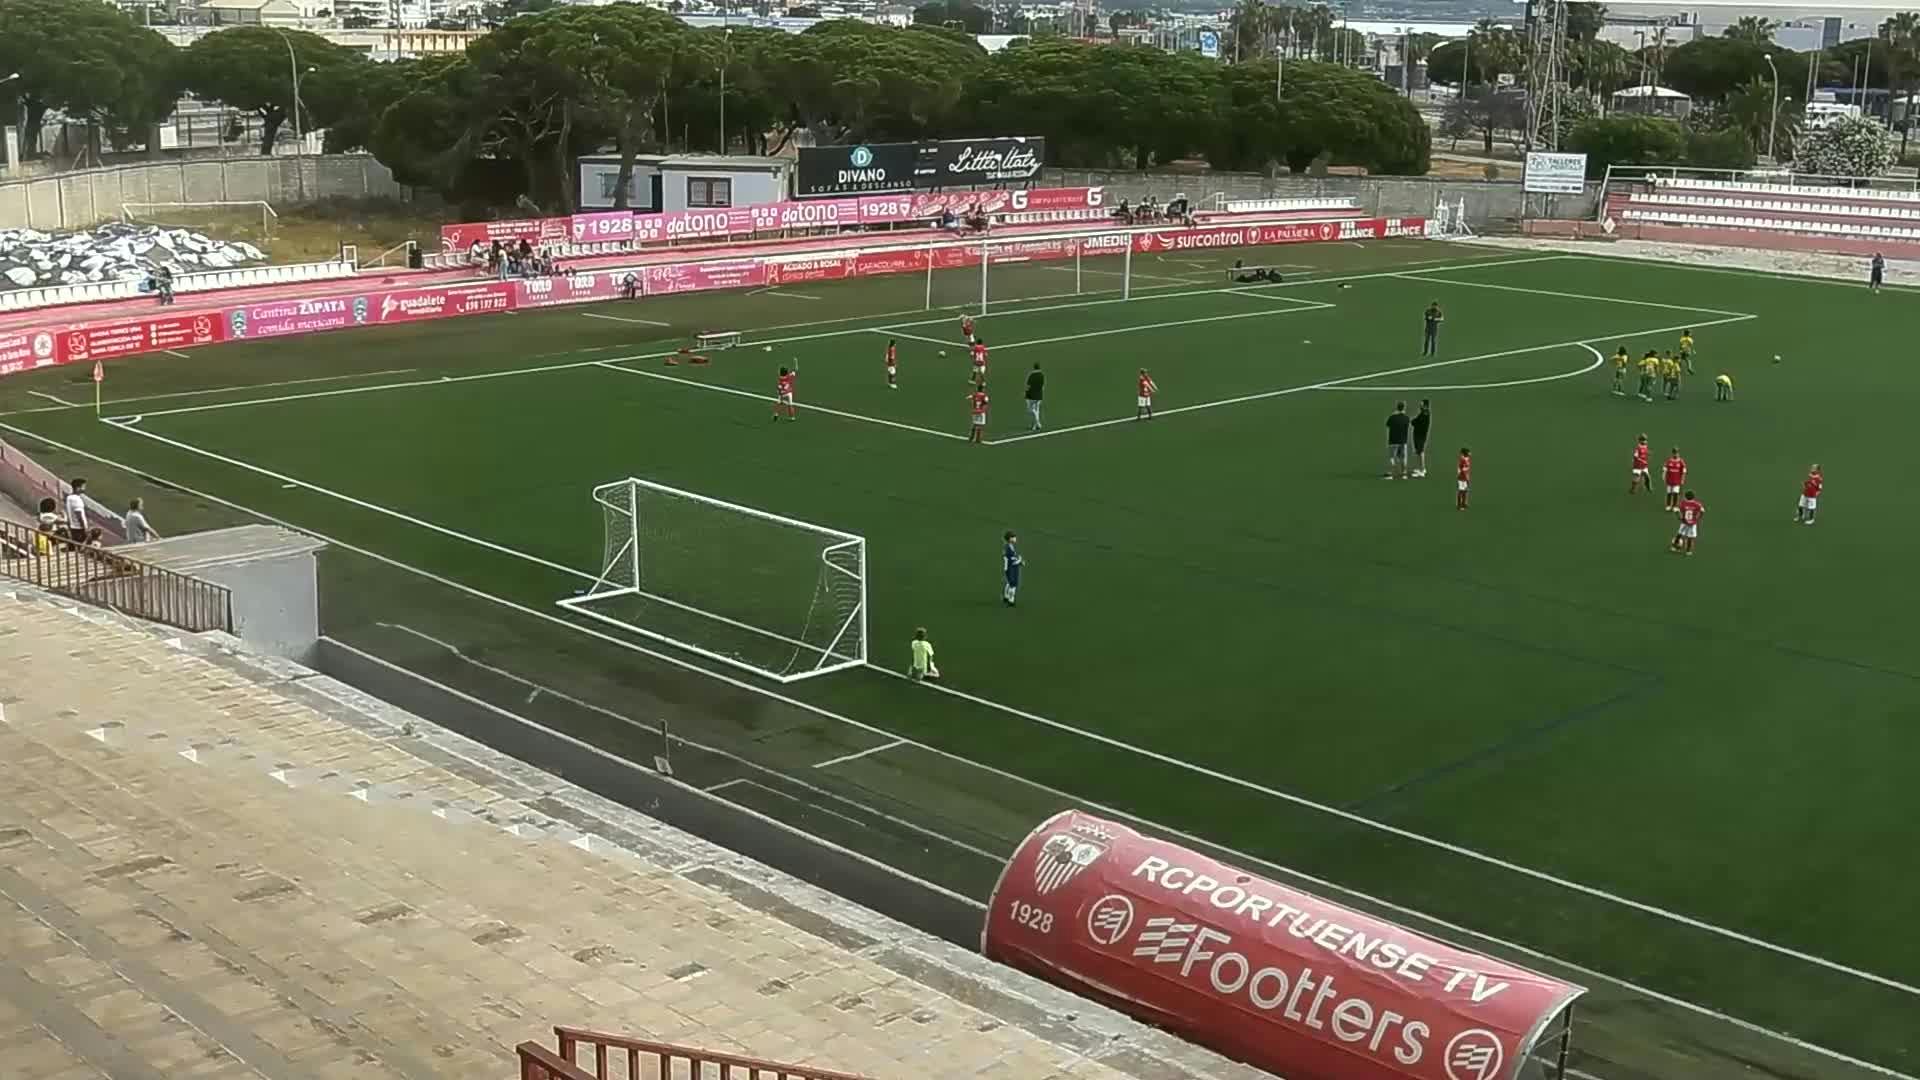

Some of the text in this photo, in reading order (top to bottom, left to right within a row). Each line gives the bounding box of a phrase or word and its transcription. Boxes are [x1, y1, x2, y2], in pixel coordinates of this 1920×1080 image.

[948, 147, 998, 173] Little
[838, 168, 886, 184] DIVANO
[781, 202, 838, 222] datono
[860, 202, 897, 217] 1928
[589, 218, 633, 235] 1928
[666, 212, 728, 233] datono
[1176, 231, 1244, 248] surcontrol
[252, 300, 346, 320] Cantina ZAPATA
[258, 316, 345, 334] comida mexicana
[1009, 898, 1055, 935] 1928
[1131, 854, 1511, 1006] RCPORTUENSE TV
[1180, 926, 1432, 1066] Footters
